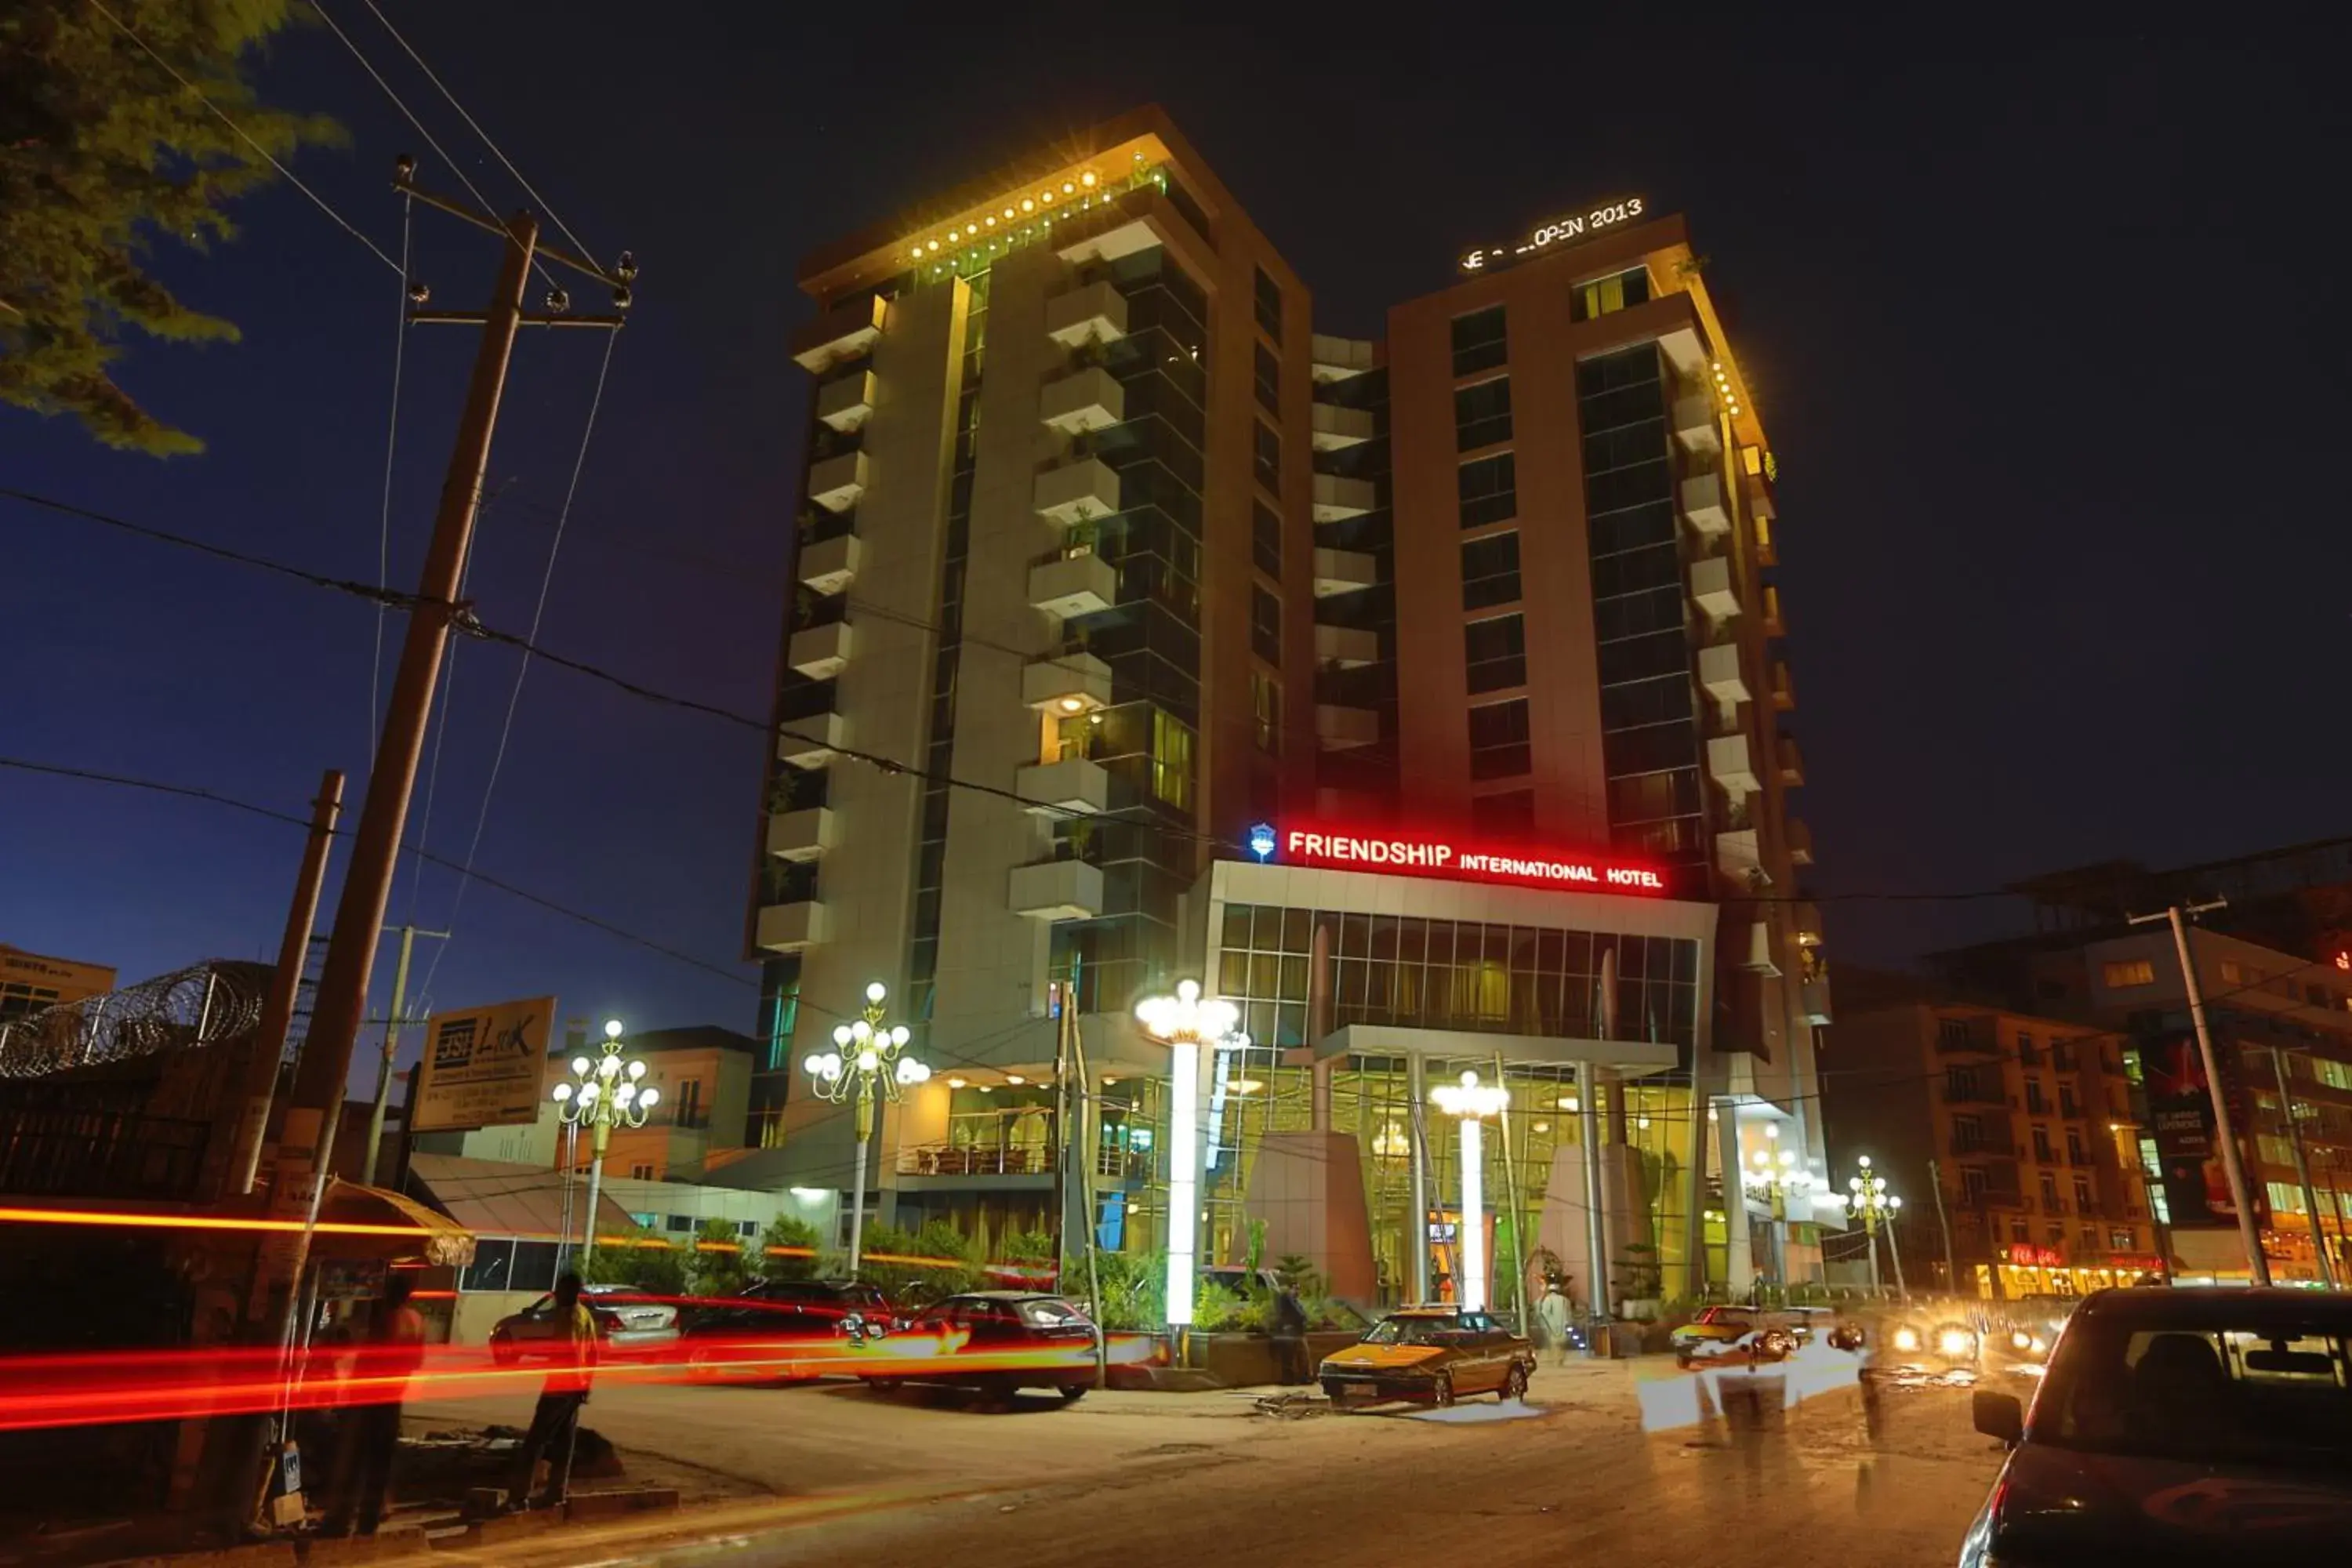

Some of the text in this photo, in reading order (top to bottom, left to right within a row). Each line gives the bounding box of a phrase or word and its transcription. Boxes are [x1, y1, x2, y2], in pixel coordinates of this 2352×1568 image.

[1589, 198, 1643, 229] 2013
[1289, 832, 1663, 887] FRIENDSHIP INTERNATIONAL HOTEL
